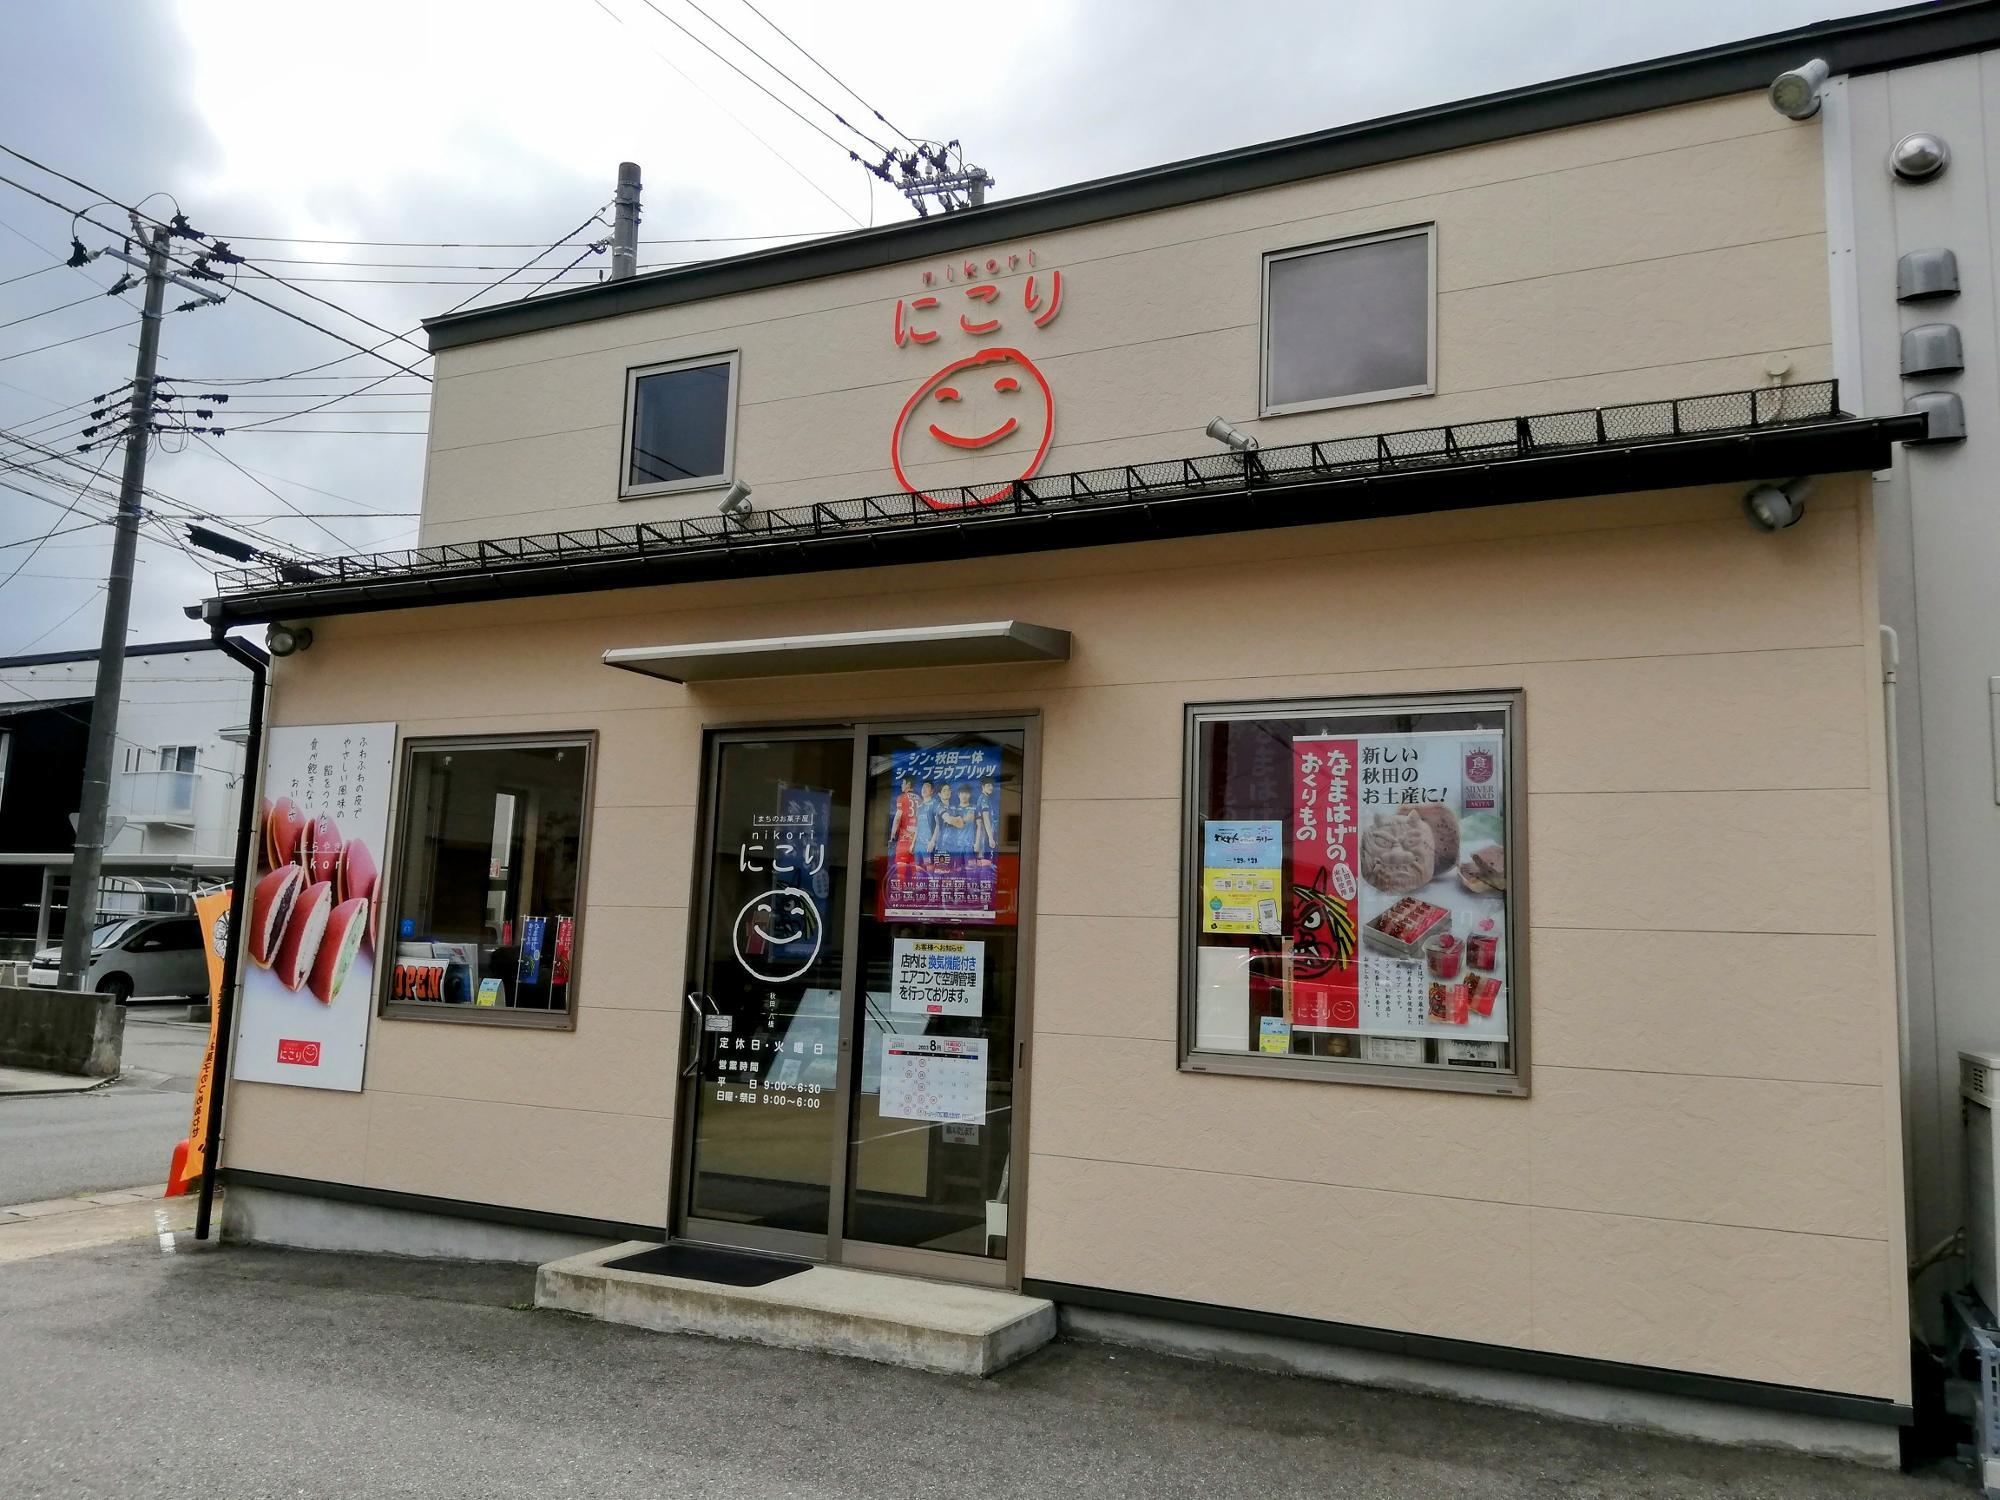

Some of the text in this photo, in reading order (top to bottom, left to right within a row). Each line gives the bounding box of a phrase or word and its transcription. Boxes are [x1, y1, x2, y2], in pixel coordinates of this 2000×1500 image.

[922, 248, 1035, 286] nikori
[895, 269, 1061, 347] にこり
[909, 750, 984, 765] シン・秋田一体
[1362, 746, 1418, 765] 新しい
[305, 738, 319, 809] 食べ飽きない
[336, 738, 351, 818] やさしい風味の
[353, 737, 367, 819] ふわふわの皮で
[895, 764, 997, 780] シン・ブラウブリッツ
[1362, 767, 1418, 784] 秋田の
[1296, 752, 1323, 841] おくりもの
[1465, 785, 1494, 793] SILVER
[1465, 792, 1495, 800] AWARD
[1326, 749, 1357, 862] なまはげの
[758, 814, 809, 823] まちのお菓子屋
[752, 829, 814, 840] nikori
[740, 843, 825, 875] にこり
[915, 943, 964, 951] お客様へお知らせ
[393, 964, 443, 1002] OPEN
[900, 970, 976, 987] エアコンで空調管理
[899, 985, 968, 1003] を行っております。
[280, 1049, 302, 1062] にこり
[718, 1060, 759, 1072] 営業時間
